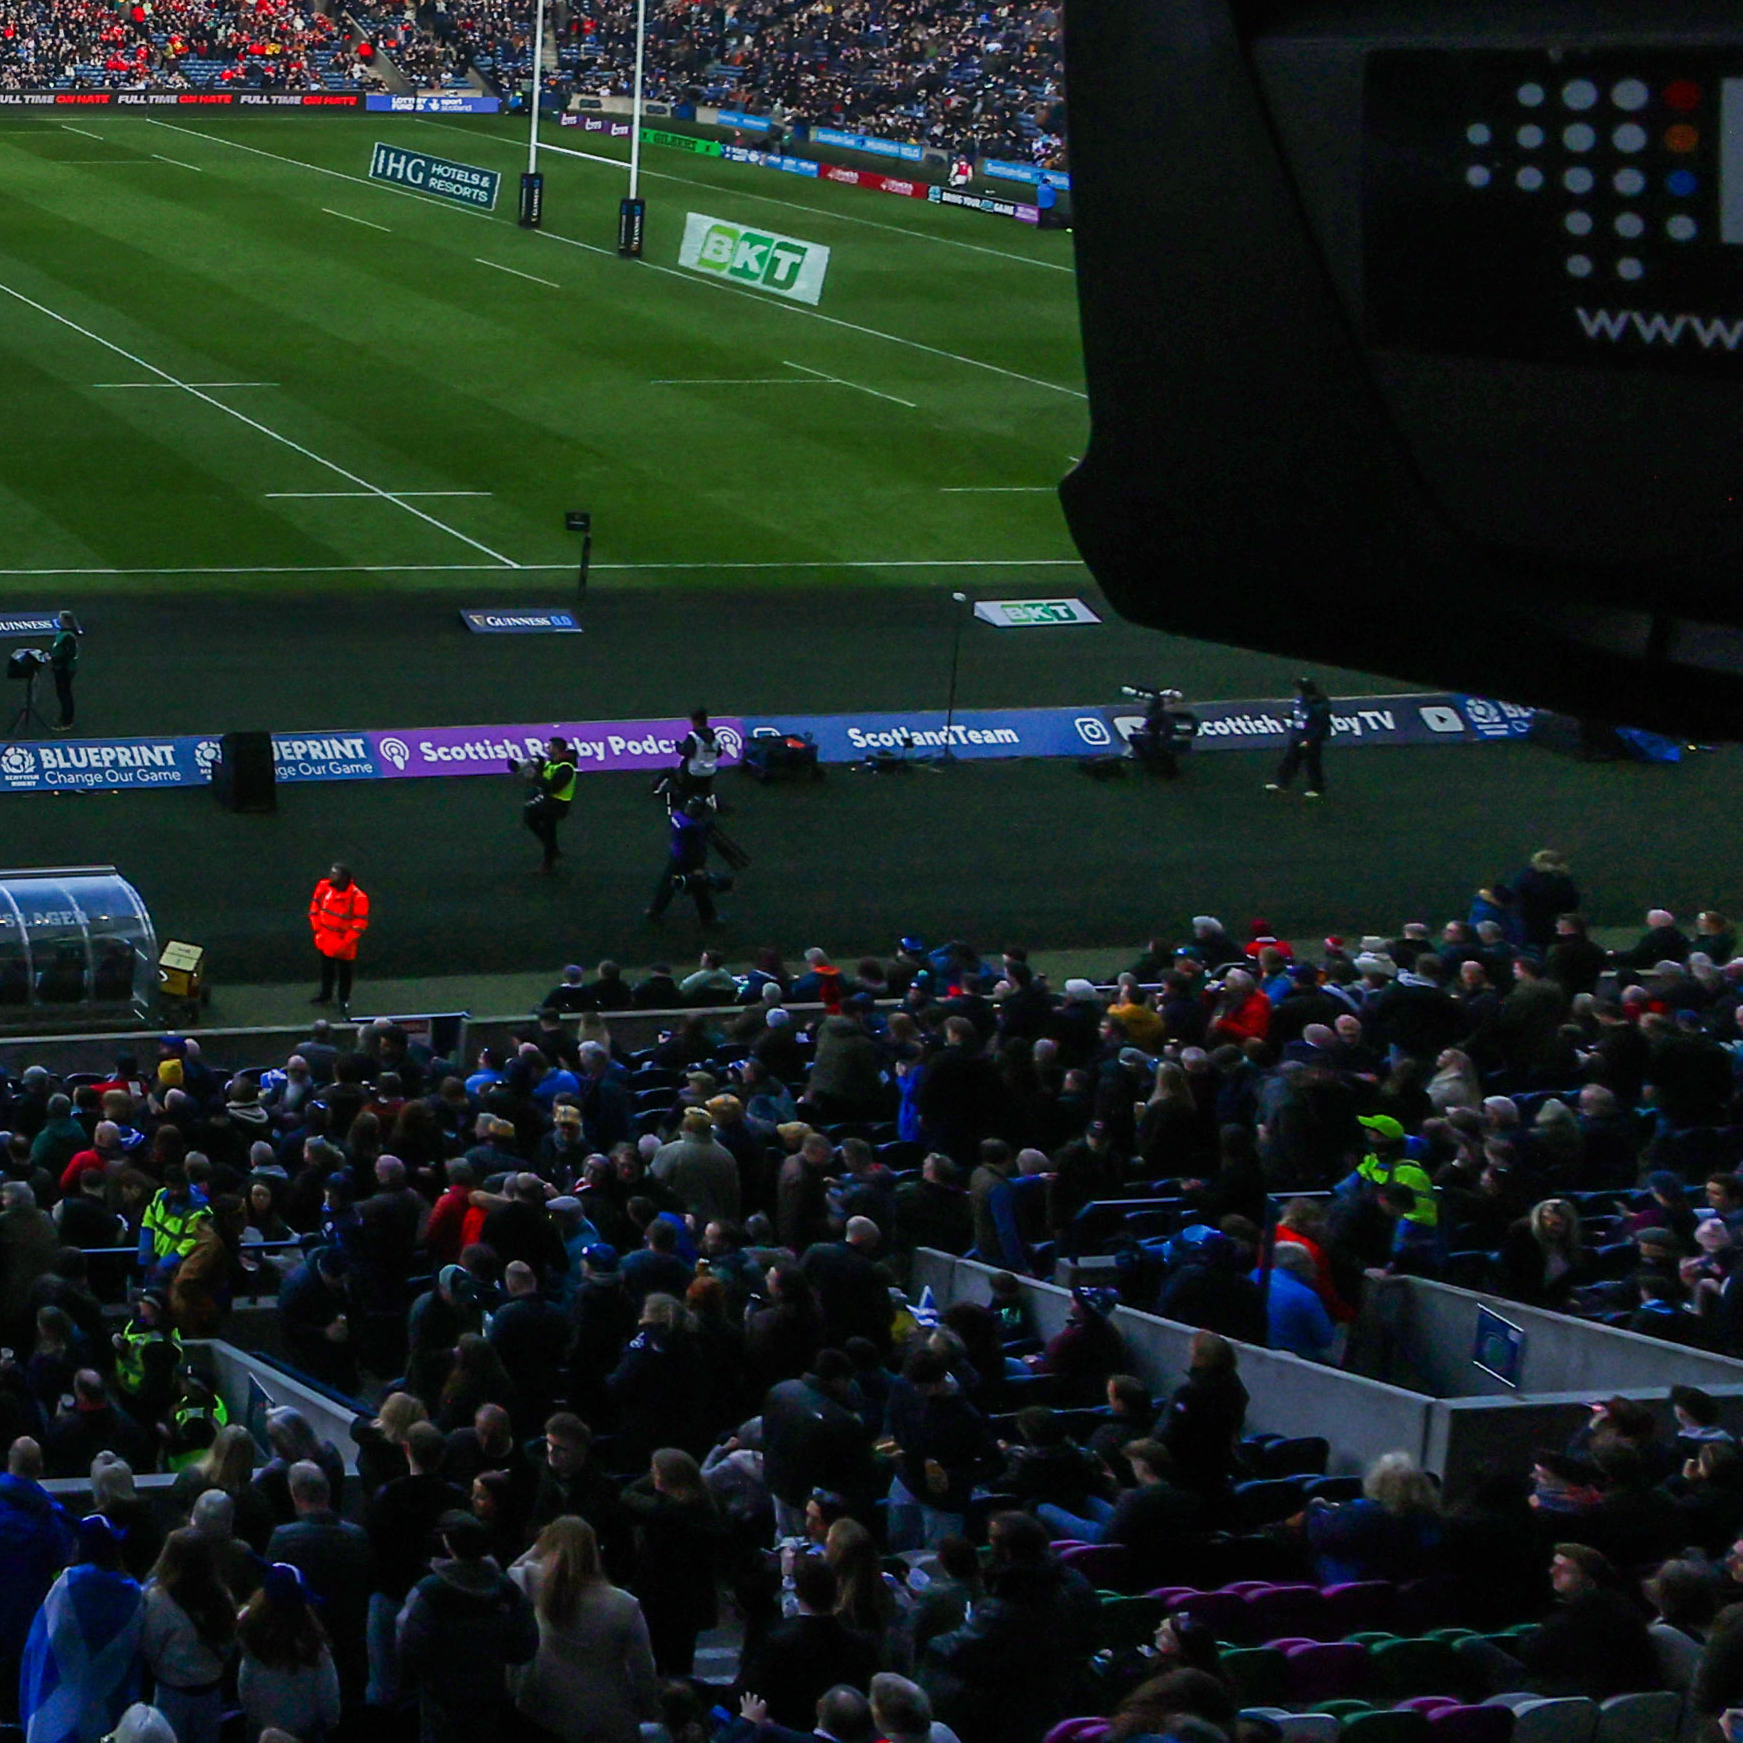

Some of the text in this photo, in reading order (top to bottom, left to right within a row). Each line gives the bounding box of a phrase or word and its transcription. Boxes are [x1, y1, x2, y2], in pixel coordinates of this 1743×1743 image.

[241, 95, 357, 105] FULL TIME ON HATE
[653, 133, 698, 152] GILBERT
[376, 149, 426, 185] IHG
[431, 163, 491, 188] HOTELS &
[428, 177, 488, 203] RESORTS
[700, 227, 804, 286] BKT
[486, 615, 572, 627] GUINNESS 0.0
[1002, 604, 1074, 622] BKT
[1197, 713, 1284, 737] cottish
[1361, 710, 1396, 731] TV
[419, 734, 678, 763] Scottish Rby Podc
[847, 724, 1020, 749] ScotlandTeam
[39, 744, 176, 769] BLUEPRINT
[273, 737, 365, 762] EPRINT
[45, 768, 181, 786] Change Our Game
[299, 761, 327, 776] Our
[331, 760, 373, 777] Game
[22, 910, 90, 928] LAGER
